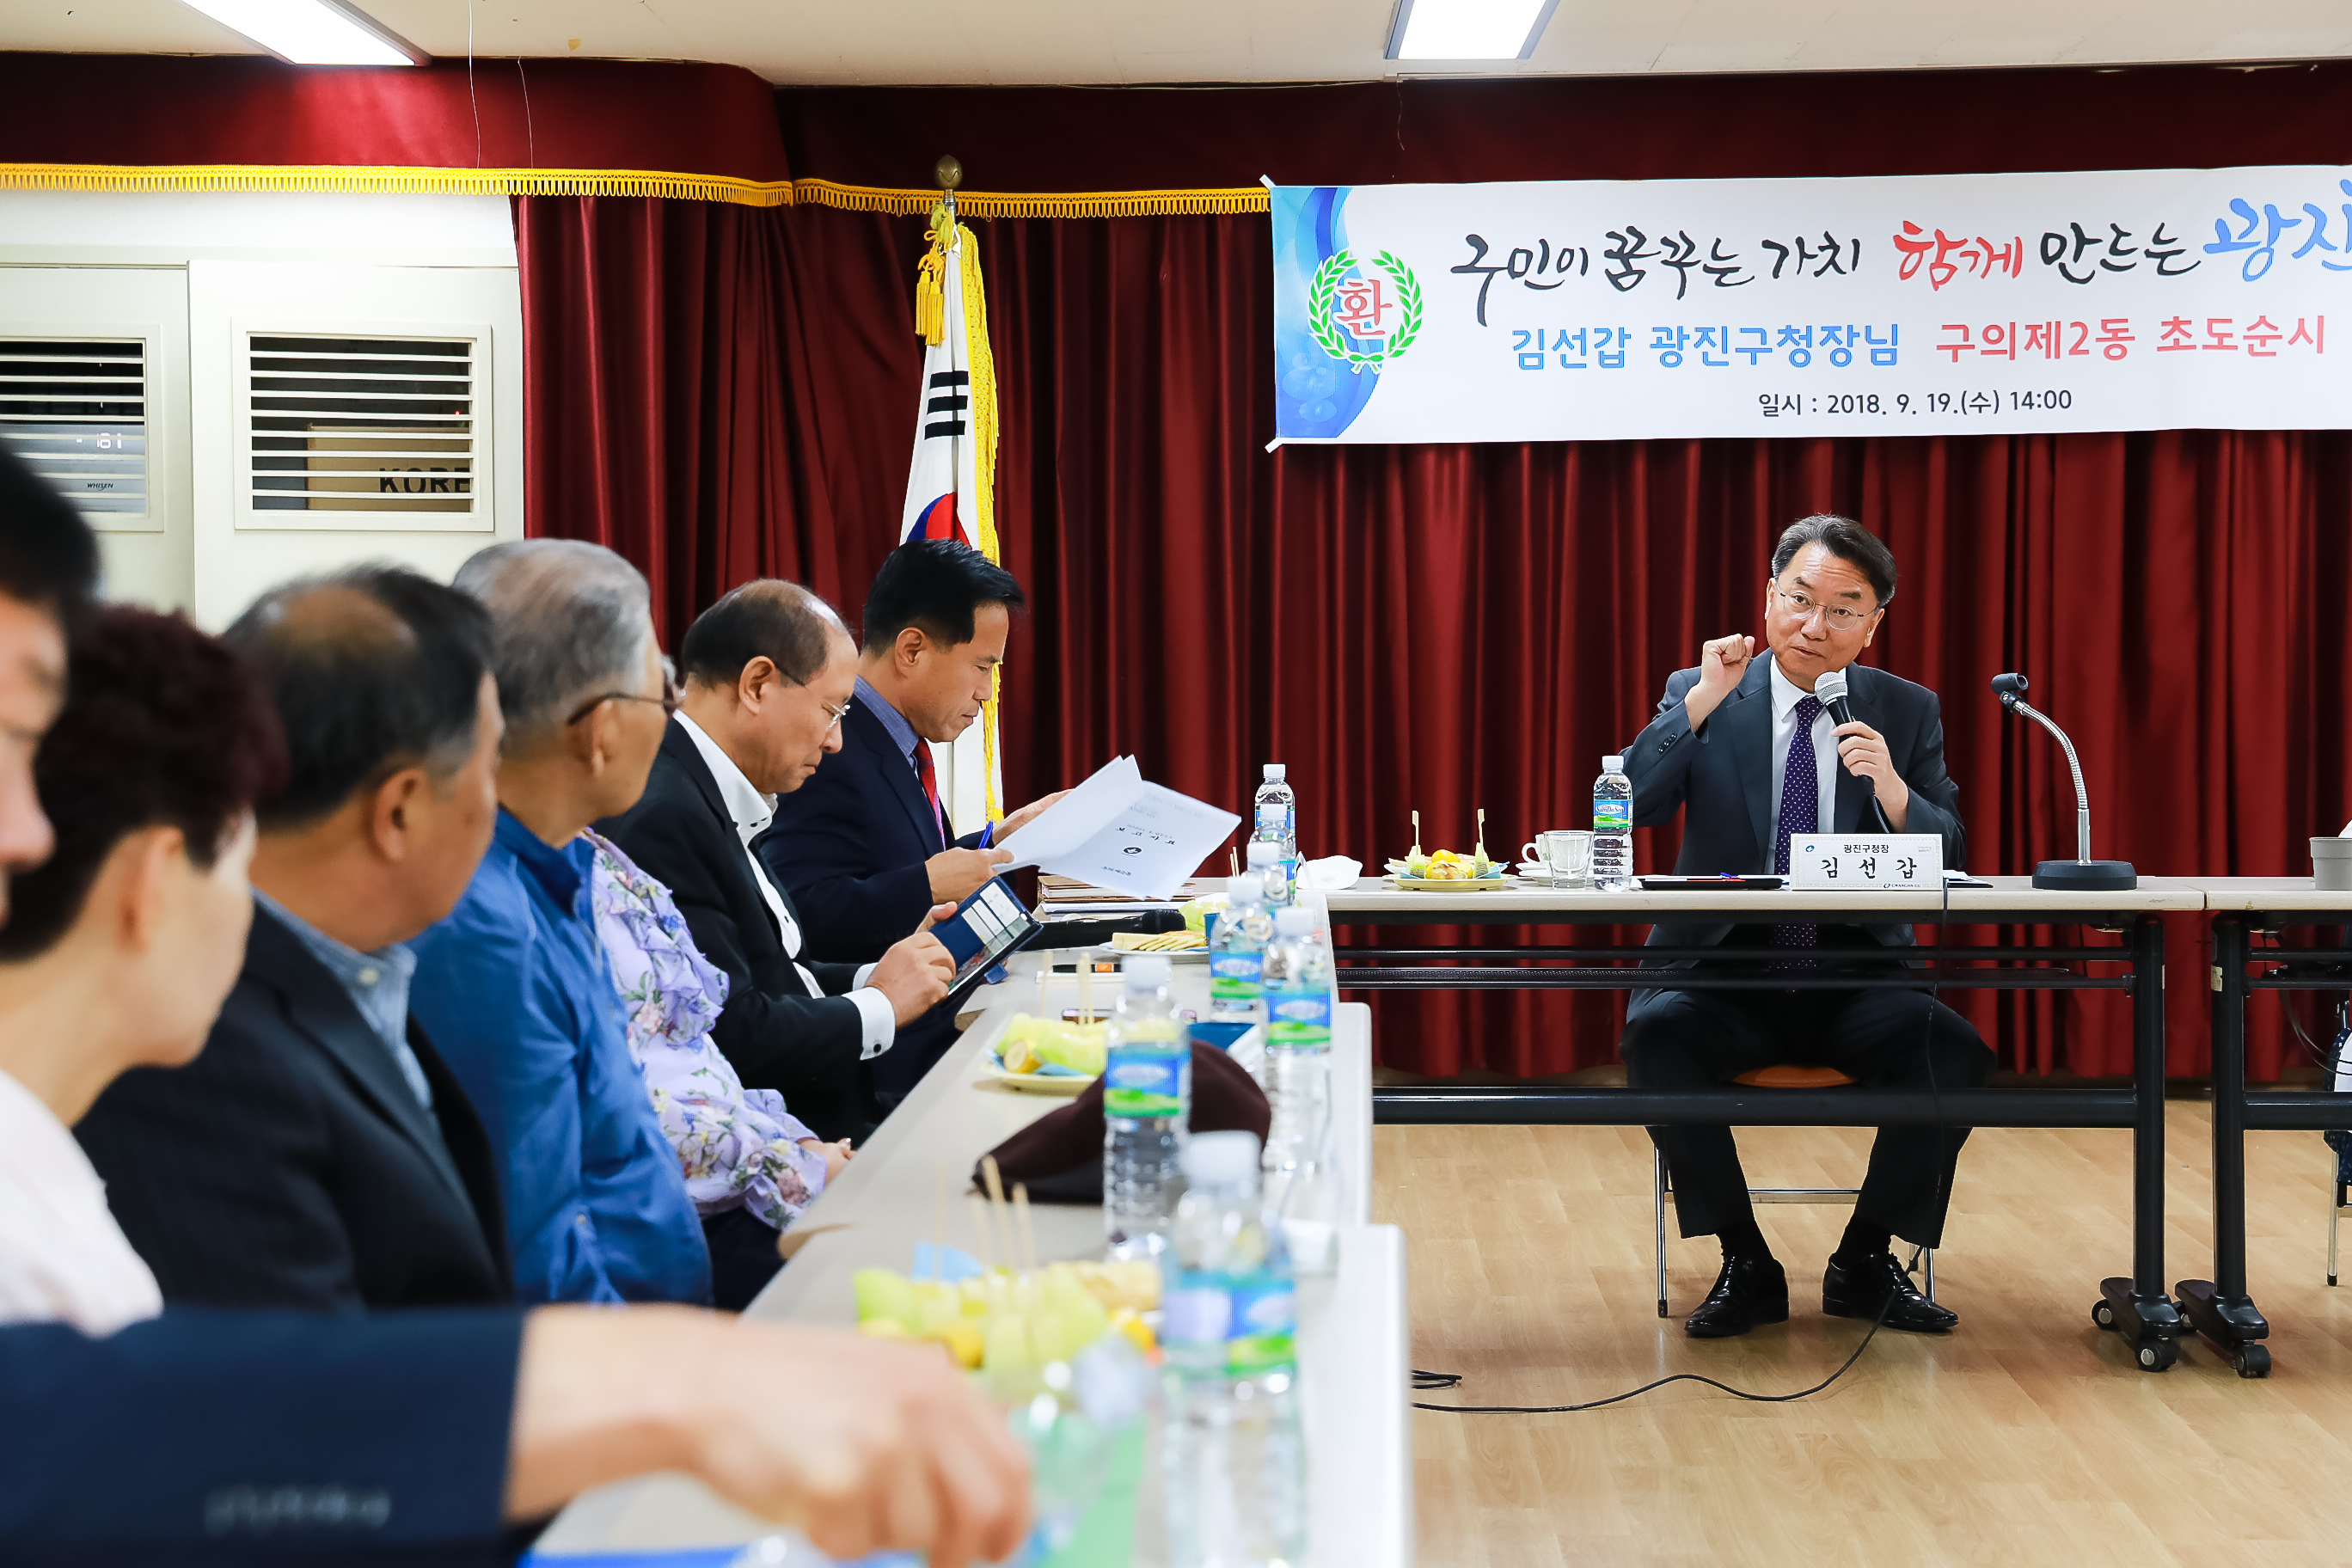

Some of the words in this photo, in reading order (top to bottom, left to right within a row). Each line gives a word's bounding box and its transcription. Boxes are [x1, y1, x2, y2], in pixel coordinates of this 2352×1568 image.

[1450, 234, 1589, 328] 구민이
[1604, 226, 1755, 300] 꿈꾸는
[1761, 231, 1861, 279] 가치
[1893, 221, 2023, 291] 함께
[2040, 223, 2201, 285] 만드는
[1332, 279, 1393, 337] 환
[1511, 327, 1632, 370] 김선갑
[1650, 324, 1898, 368] 광진구청장님
[1936, 319, 2135, 363] 구의제2동
[2157, 315, 2324, 357] 초도순시
[1759, 394, 1801, 417] 일시
[1828, 394, 1887, 415] 2018.
[1897, 394, 1917, 414] 9.
[1927, 390, 2000, 416] 19.(수)
[2010, 390, 2072, 411] 14:00
[1821, 856, 1838, 879] 김
[1859, 856, 1876, 879] 선
[1896, 856, 1918, 879] 갑
